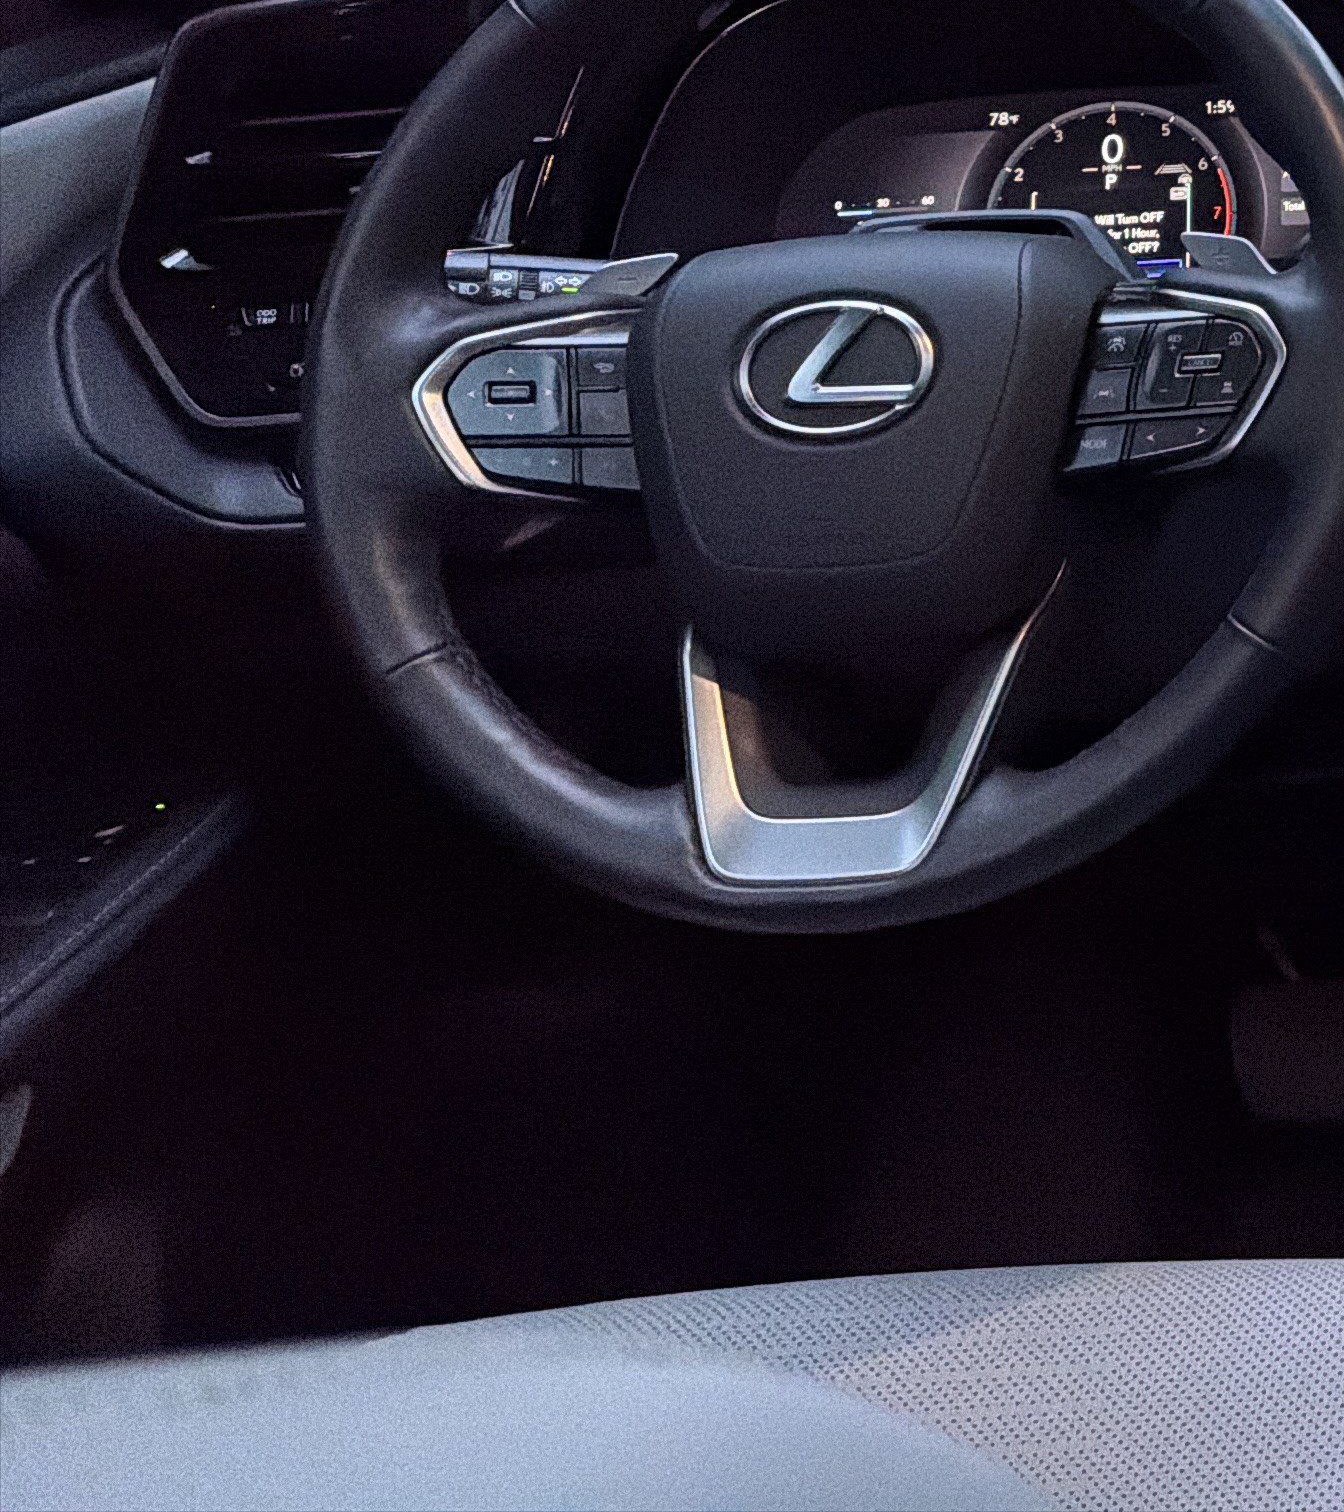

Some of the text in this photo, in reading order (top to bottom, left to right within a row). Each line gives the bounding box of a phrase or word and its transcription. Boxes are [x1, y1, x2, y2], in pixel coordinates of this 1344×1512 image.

[1106, 113, 1117, 127] 4
[1053, 129, 1064, 144] 3
[1161, 123, 1171, 137] 5
[1101, 133, 1125, 165] 0
[1101, 164, 1123, 173] MPH
[1198, 157, 1208, 171] 6
[1014, 167, 1025, 182] 2
[1104, 173, 1119, 191] P
[1115, 213, 1139, 226] Turn
[1140, 210, 1164, 224] OFF
[1213, 205, 1222, 220] 7
[1131, 227, 1160, 240] Hour.
[1127, 241, 1160, 254] OFF?
